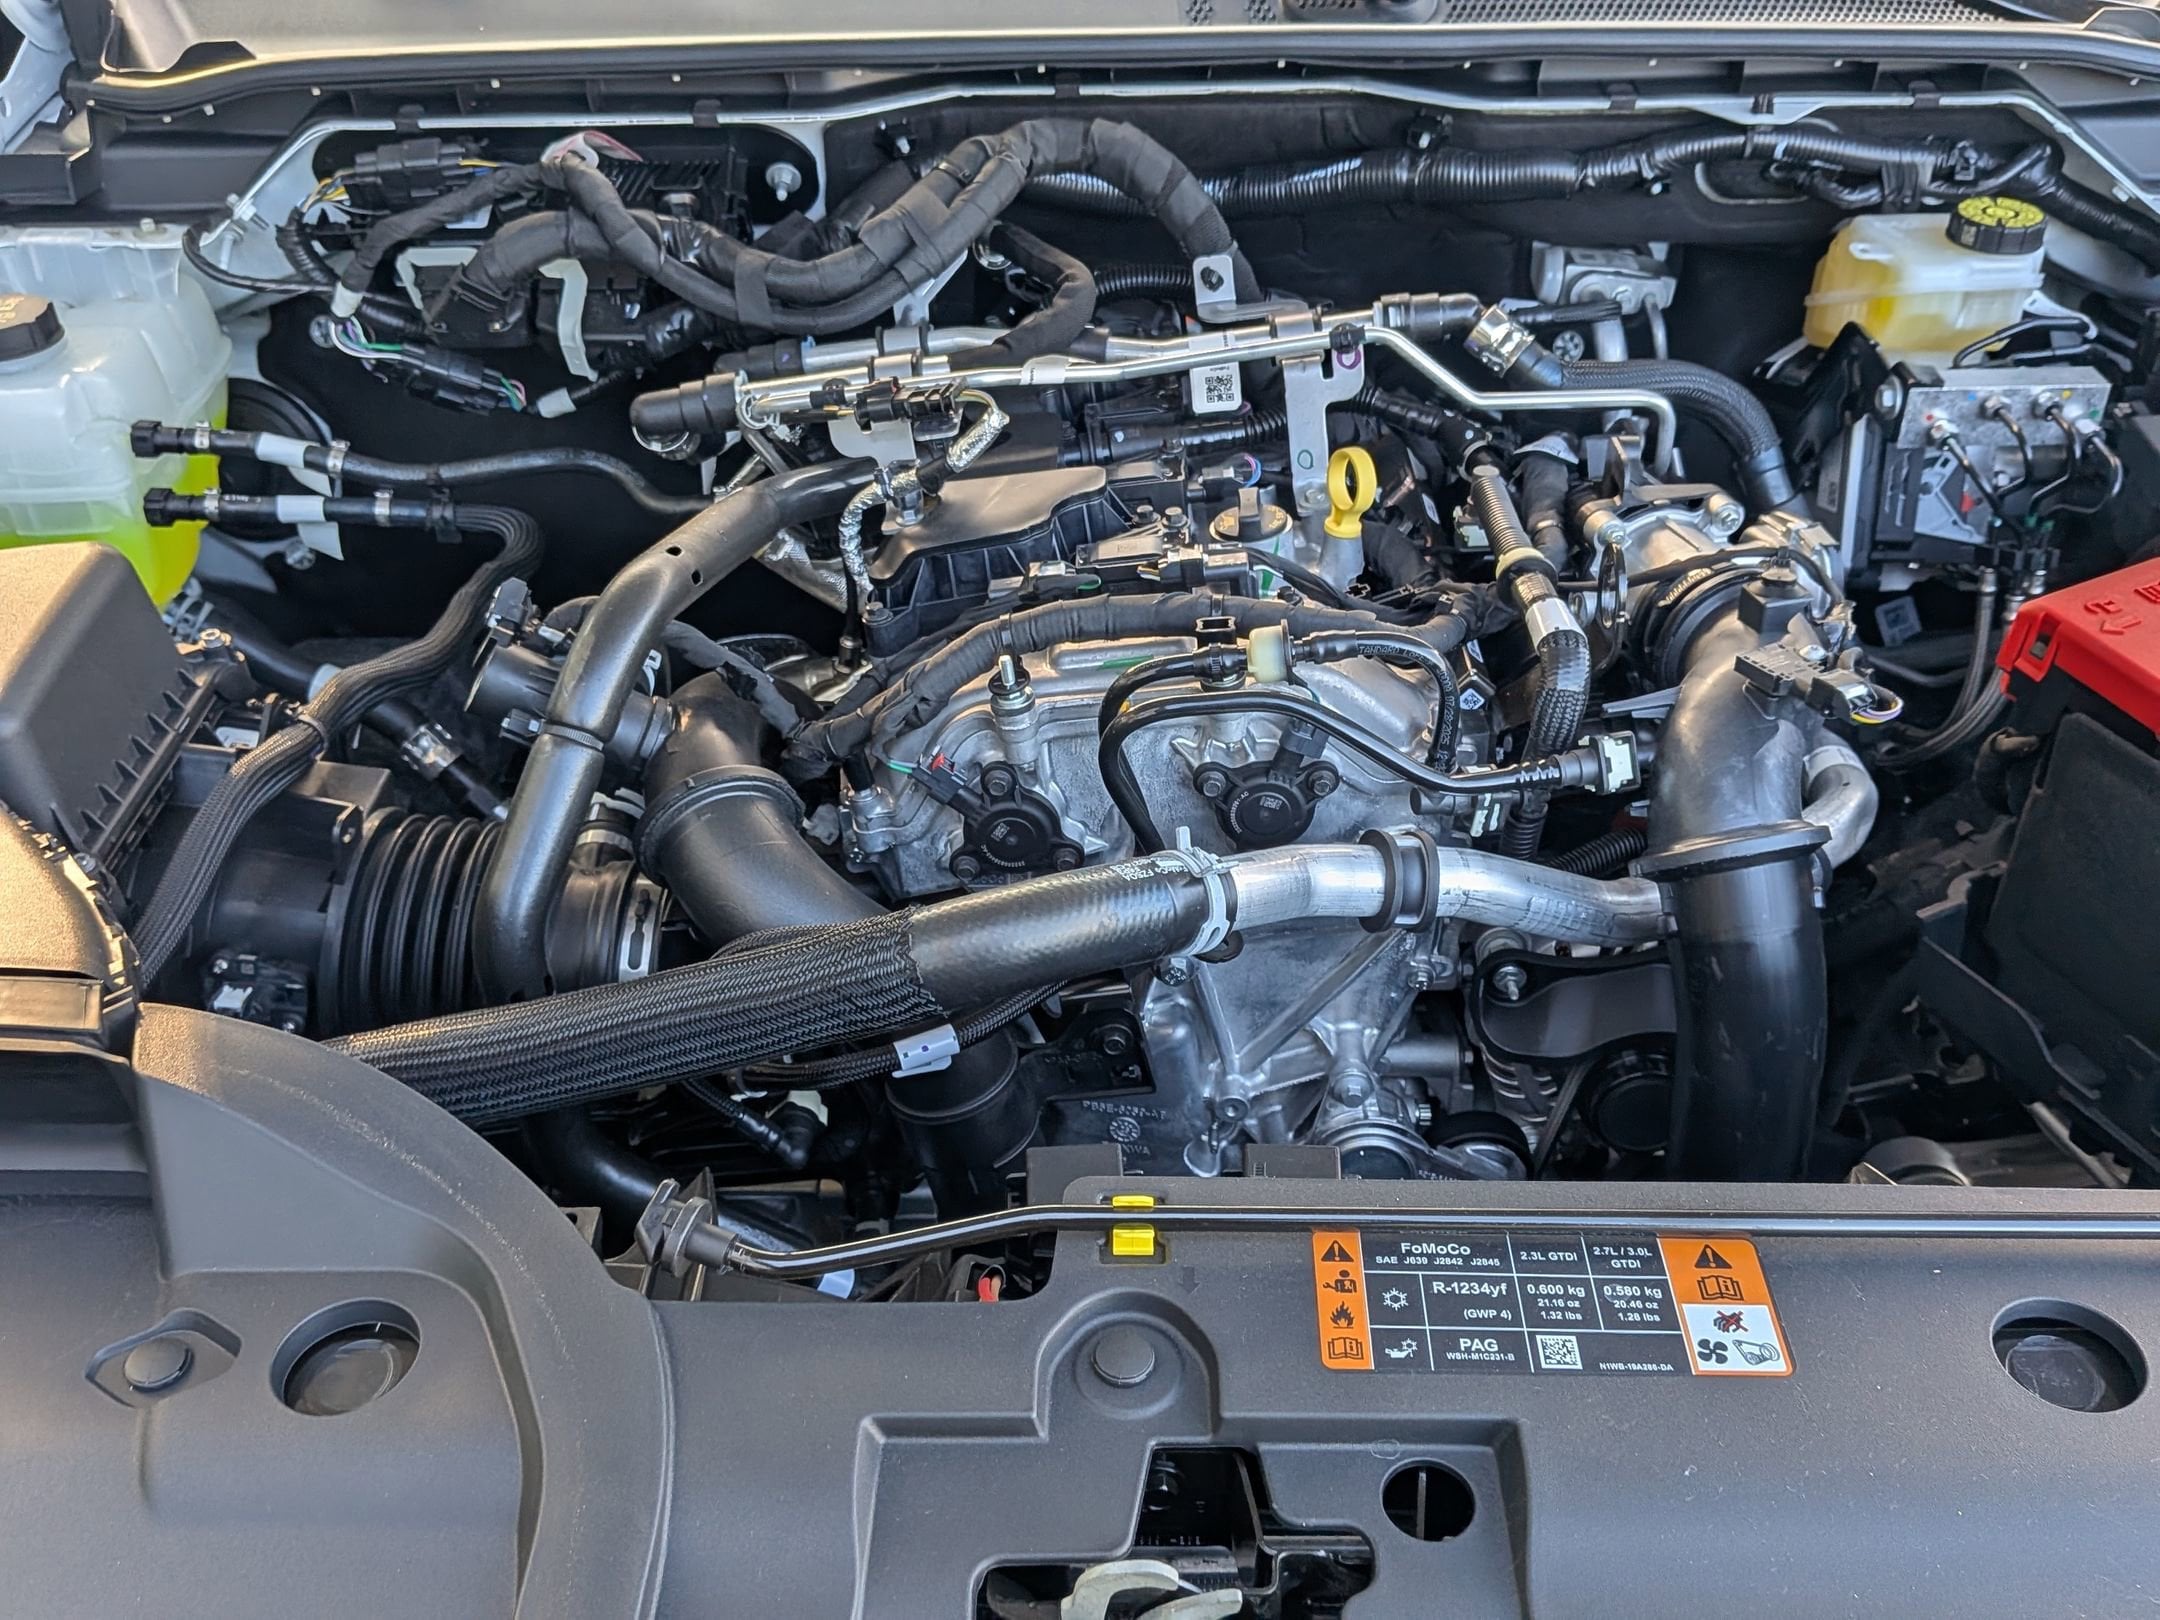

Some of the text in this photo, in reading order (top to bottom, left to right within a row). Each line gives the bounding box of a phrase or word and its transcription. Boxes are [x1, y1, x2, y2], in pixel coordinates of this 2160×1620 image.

[1358, 645, 1400, 655] TANDARD
[1400, 1243, 1471, 1256] FoMoCo
[1593, 1247, 1618, 1256] 2.7L
[1627, 1247, 1653, 1257] 3.0L
[1375, 1256, 1398, 1264] SAE
[1434, 1257, 1464, 1265] J2842
[1470, 1258, 1500, 1266] J2845
[1520, 1251, 1578, 1261] 2.3L GTDI
[1611, 1259, 1641, 1269] GTDI
[1432, 1281, 1507, 1298] R-1234yf
[1527, 1284, 1585, 1297] 0.600 kg
[1603, 1285, 1663, 1299] 0.580 kg
[1537, 1298, 1563, 1307] 21.16
[1613, 1300, 1642, 1309] 20.46
[1463, 1309, 1512, 1321] (GWP 4)
[1540, 1311, 1582, 1320] 1.32 lbs
[1618, 1312, 1661, 1322] 1.28 lbs
[1459, 1338, 1499, 1352] PAG
